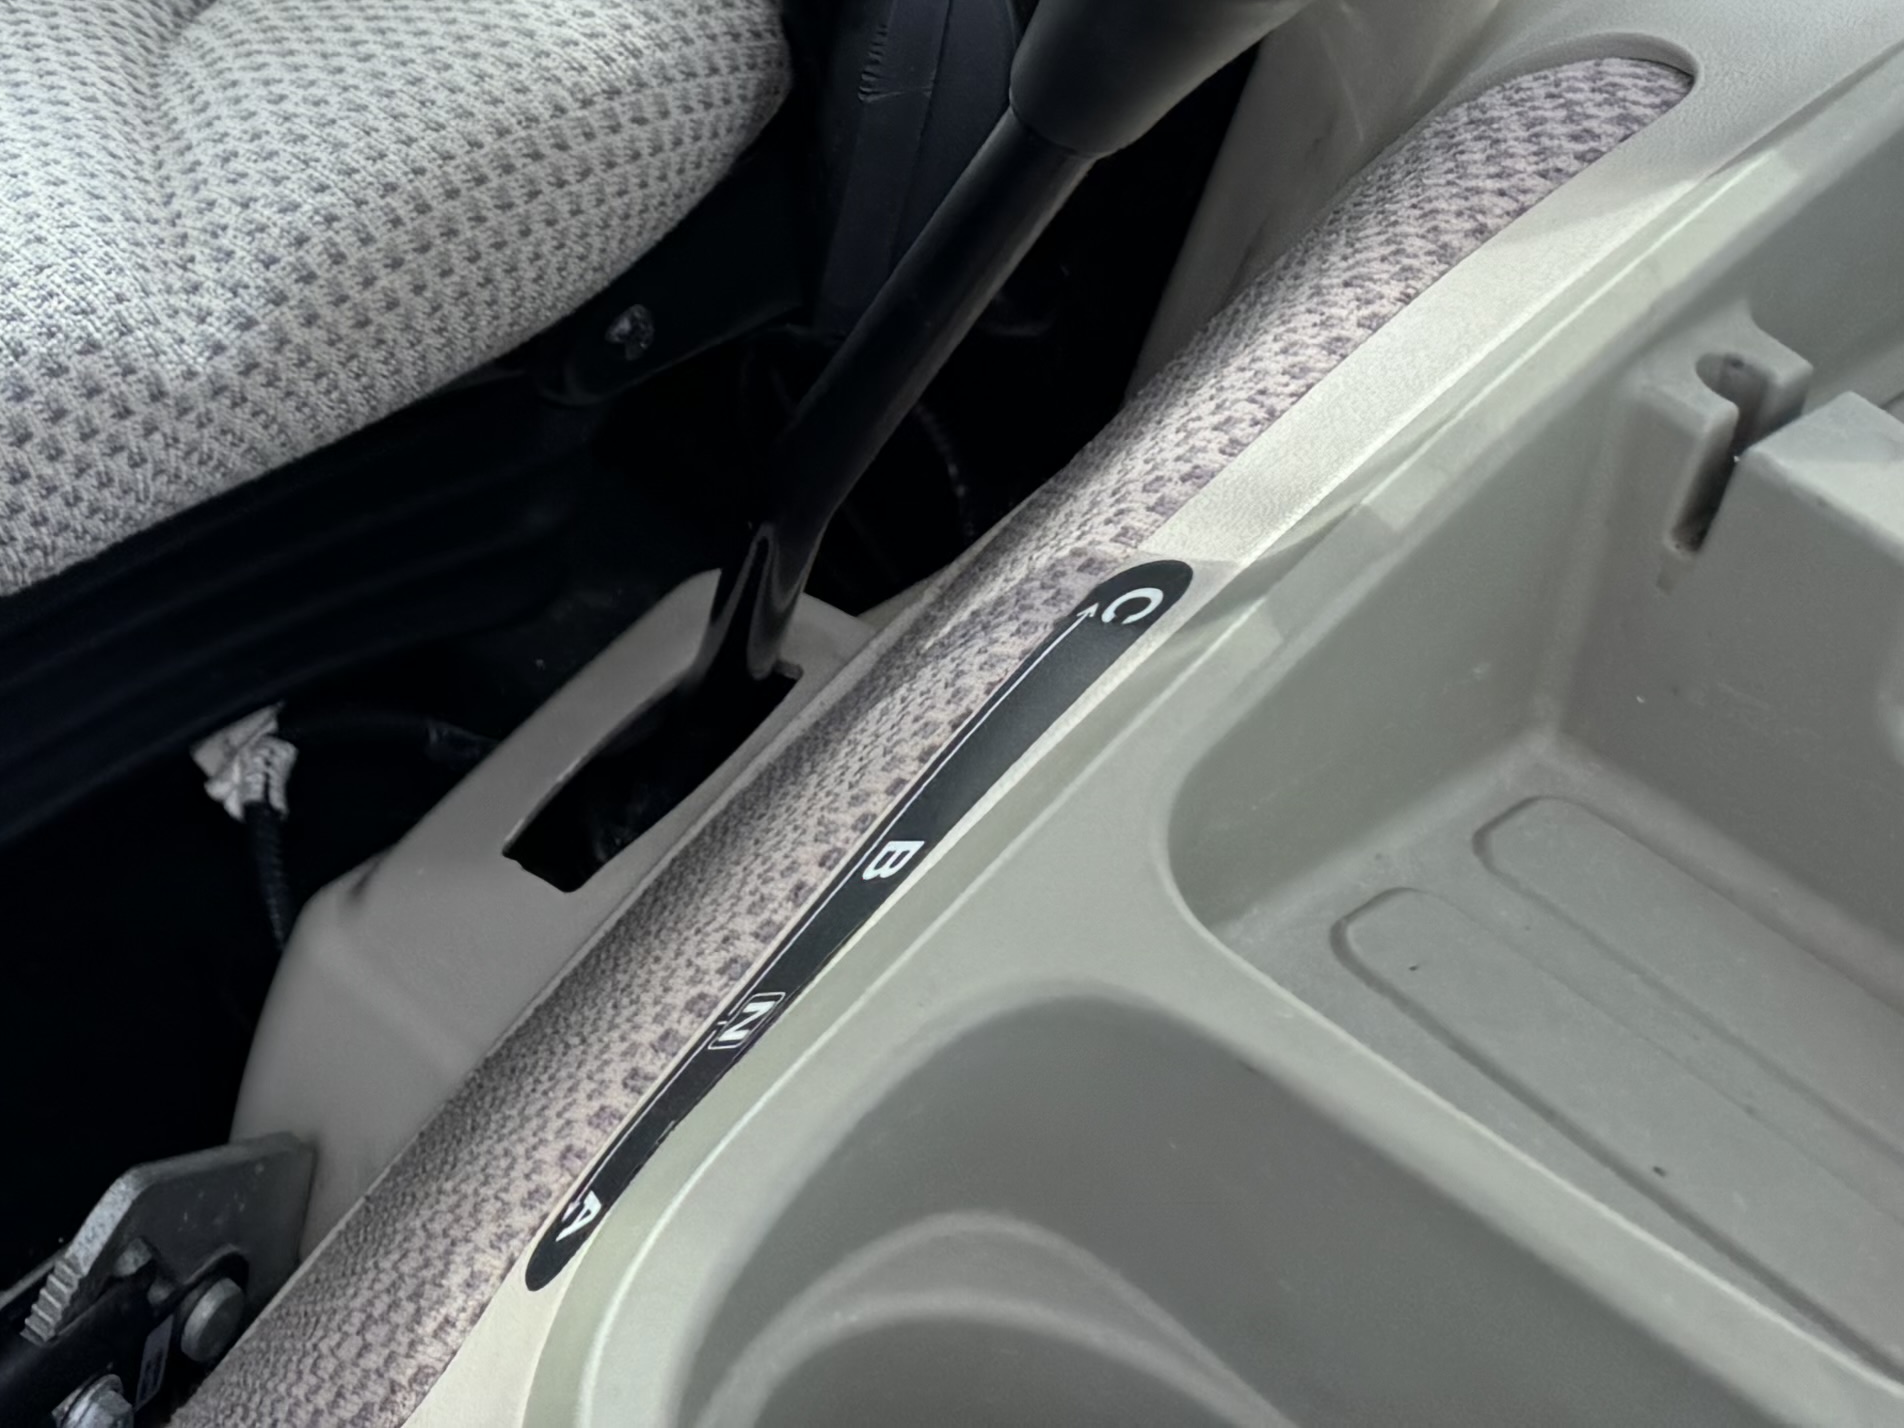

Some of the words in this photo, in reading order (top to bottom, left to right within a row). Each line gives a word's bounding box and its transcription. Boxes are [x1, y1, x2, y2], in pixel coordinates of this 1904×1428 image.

[1101, 586, 1164, 627] C
[861, 839, 925, 881] B
[719, 1001, 775, 1044] N
[556, 1191, 602, 1241] A
